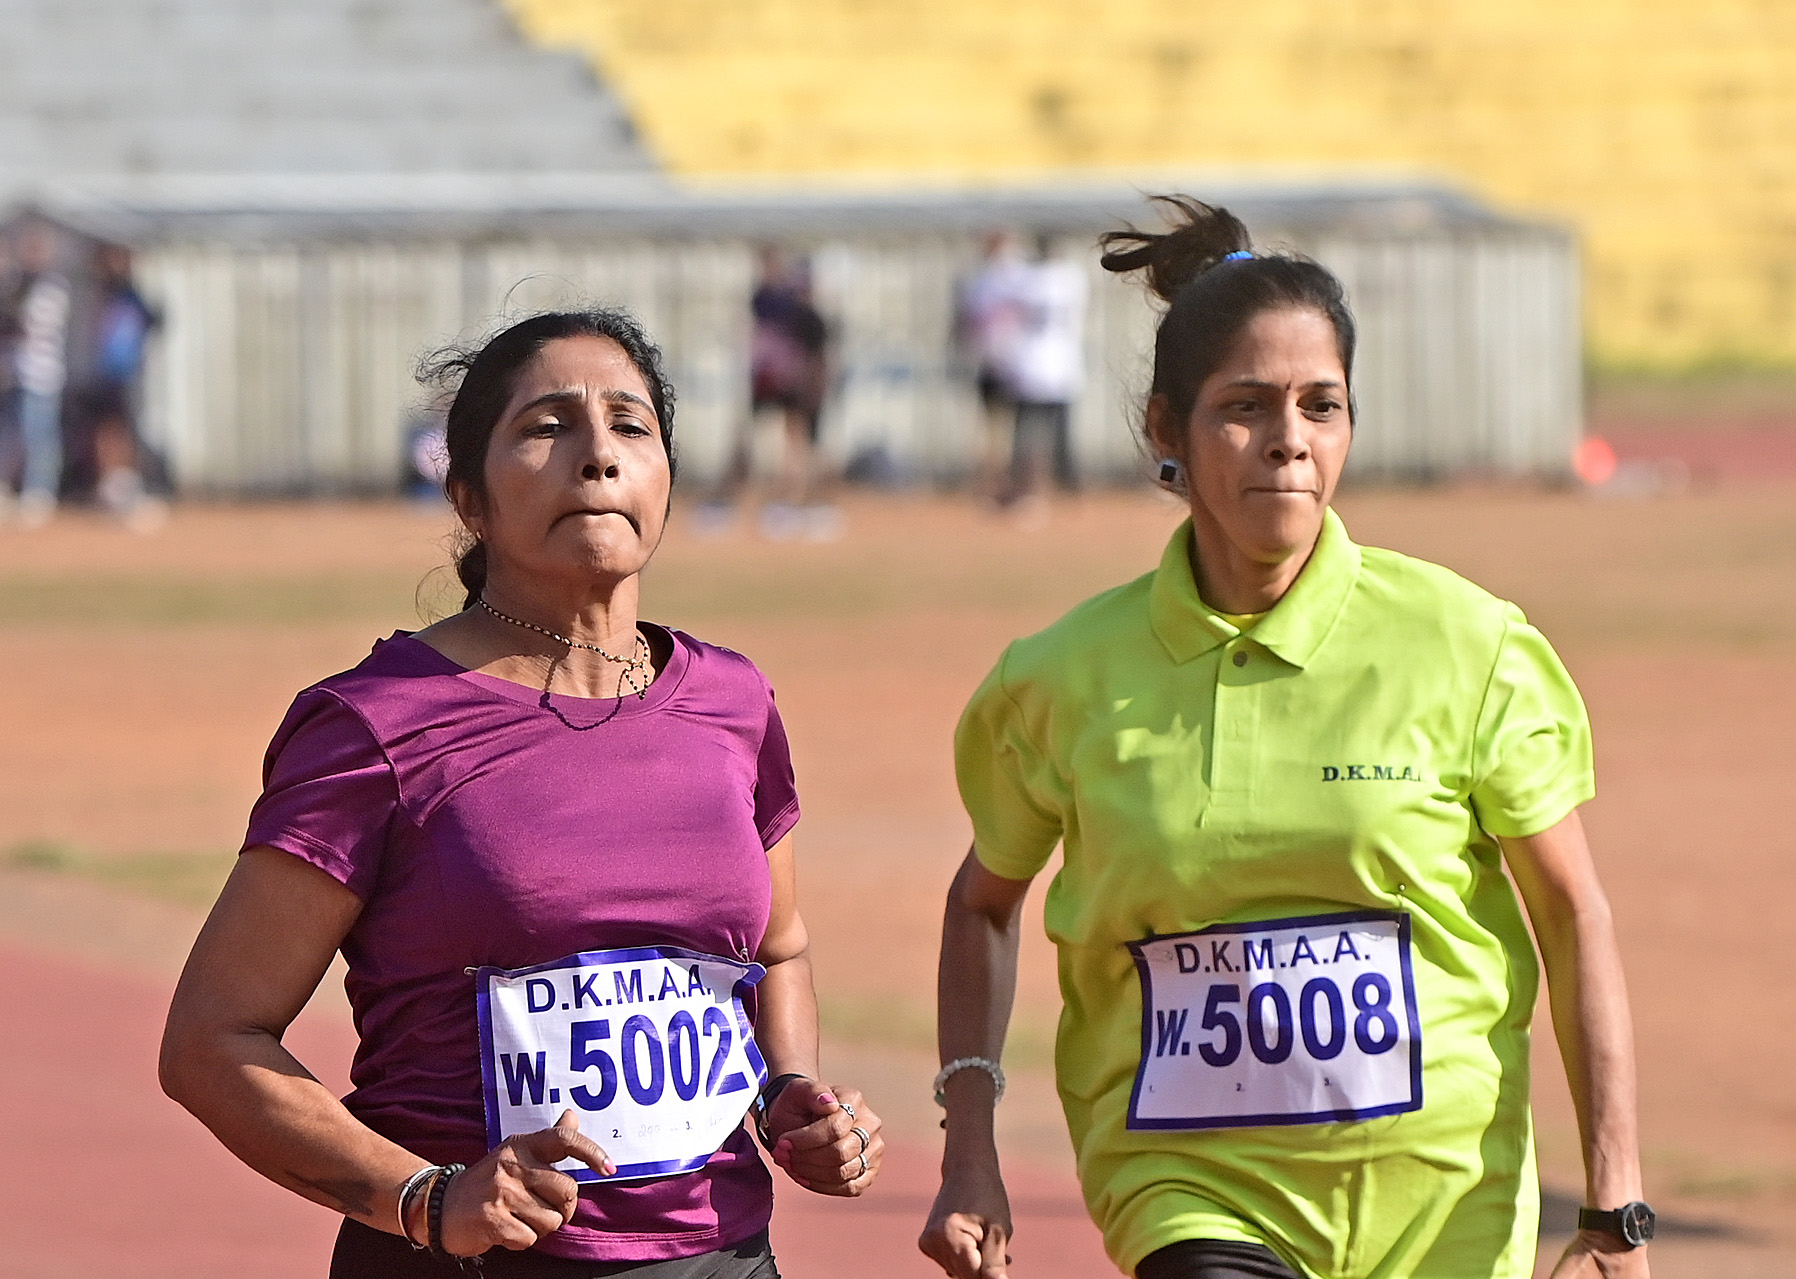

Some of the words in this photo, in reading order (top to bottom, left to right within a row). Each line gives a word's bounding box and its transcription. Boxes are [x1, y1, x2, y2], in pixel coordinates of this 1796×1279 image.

[1174, 931, 1371, 974] D.K.M.A.A.
[525, 964, 712, 1014] D.K.M.A.A.
[612, 1129, 622, 1138] 2.
